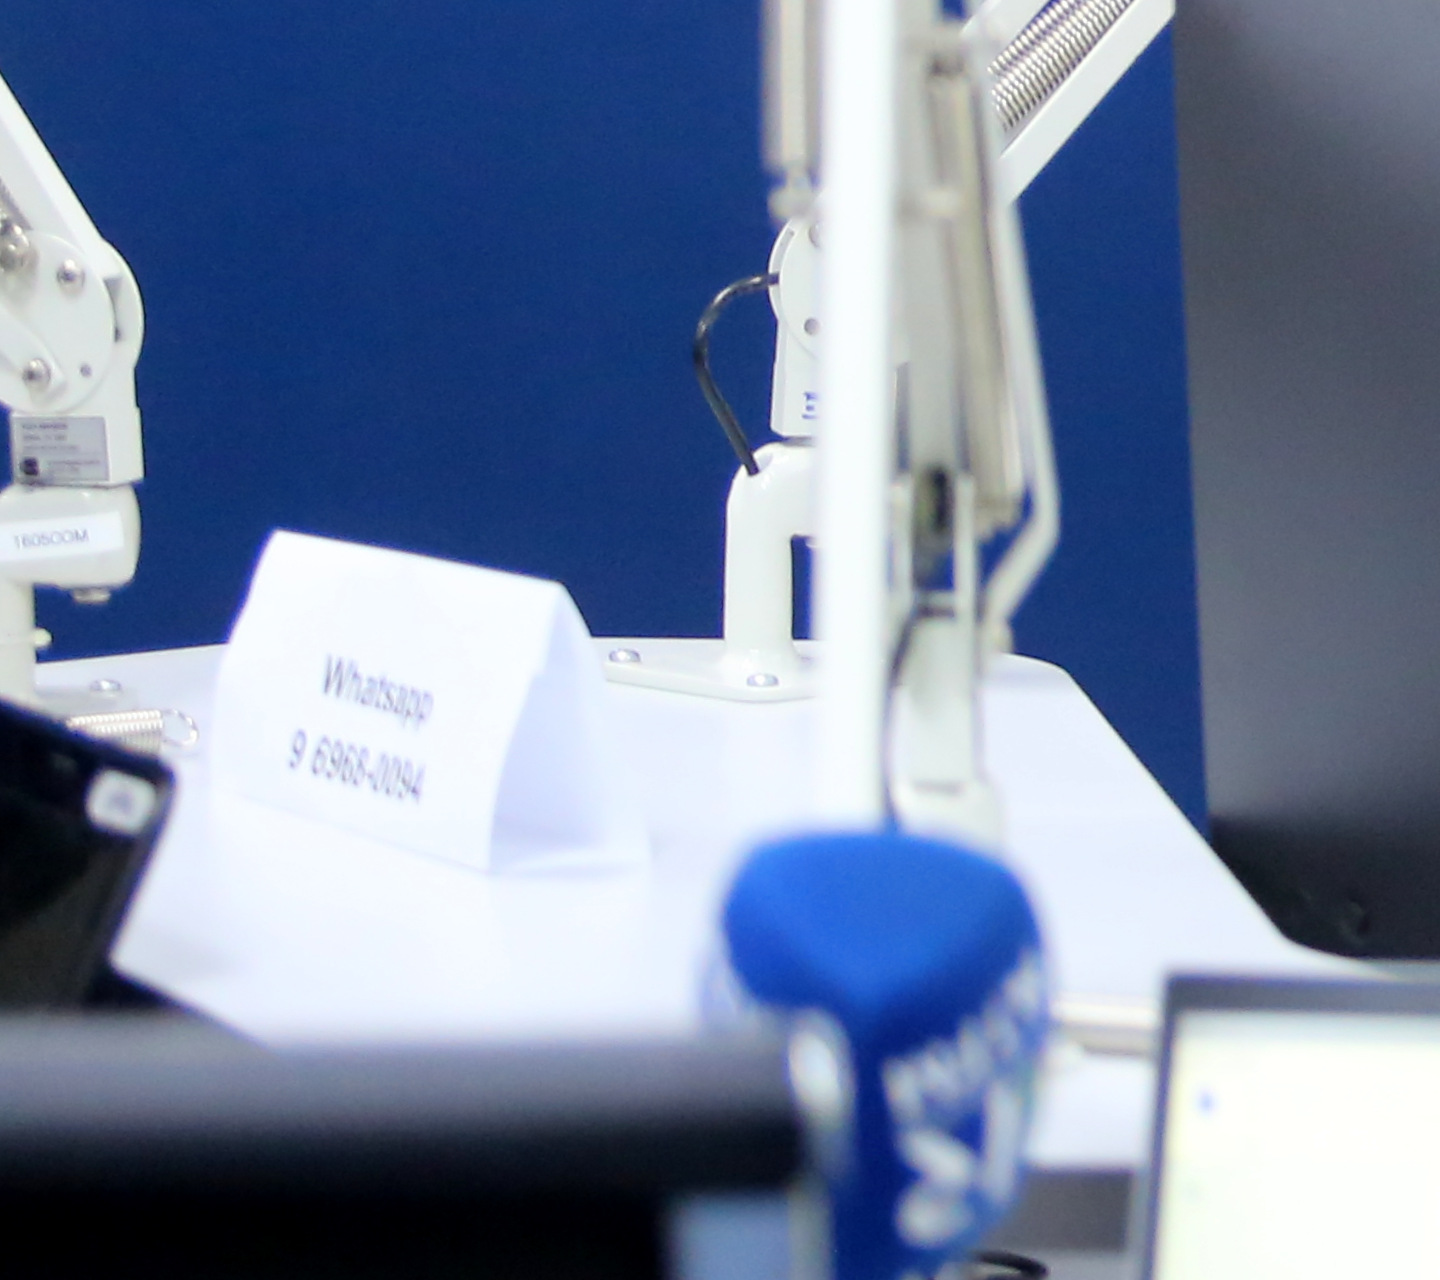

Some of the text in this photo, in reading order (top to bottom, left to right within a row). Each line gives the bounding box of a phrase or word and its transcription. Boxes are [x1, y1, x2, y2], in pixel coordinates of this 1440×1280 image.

[322, 655, 434, 729] Whatsapp
[288, 727, 426, 805] 9 6968-0094
